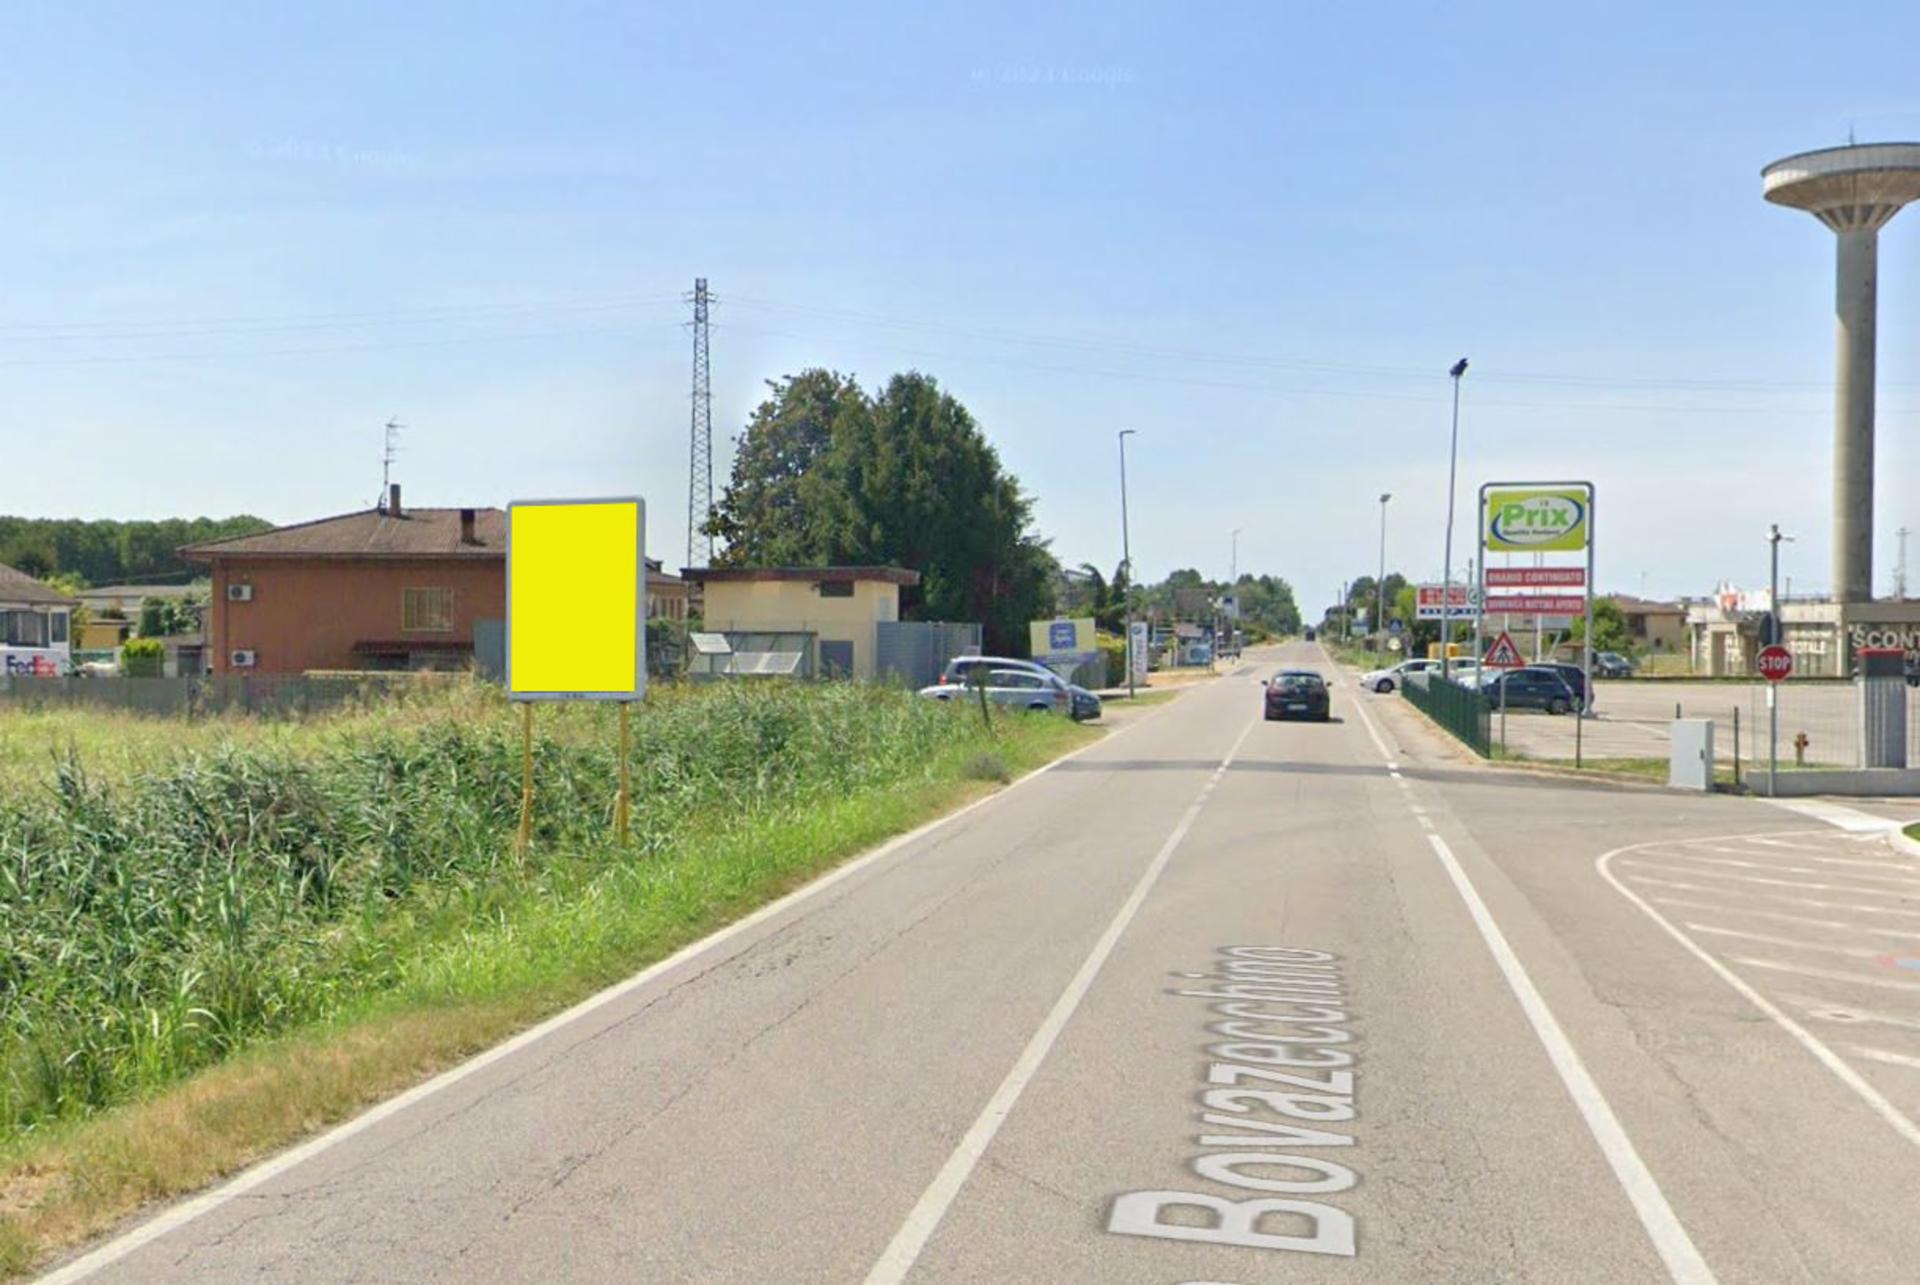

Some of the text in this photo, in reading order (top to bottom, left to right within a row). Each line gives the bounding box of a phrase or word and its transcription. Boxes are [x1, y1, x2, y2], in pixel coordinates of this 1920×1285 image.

[1503, 502, 1569, 527] Prix
[6, 654, 57, 677] FedEx
[1759, 655, 1790, 670] STOP
